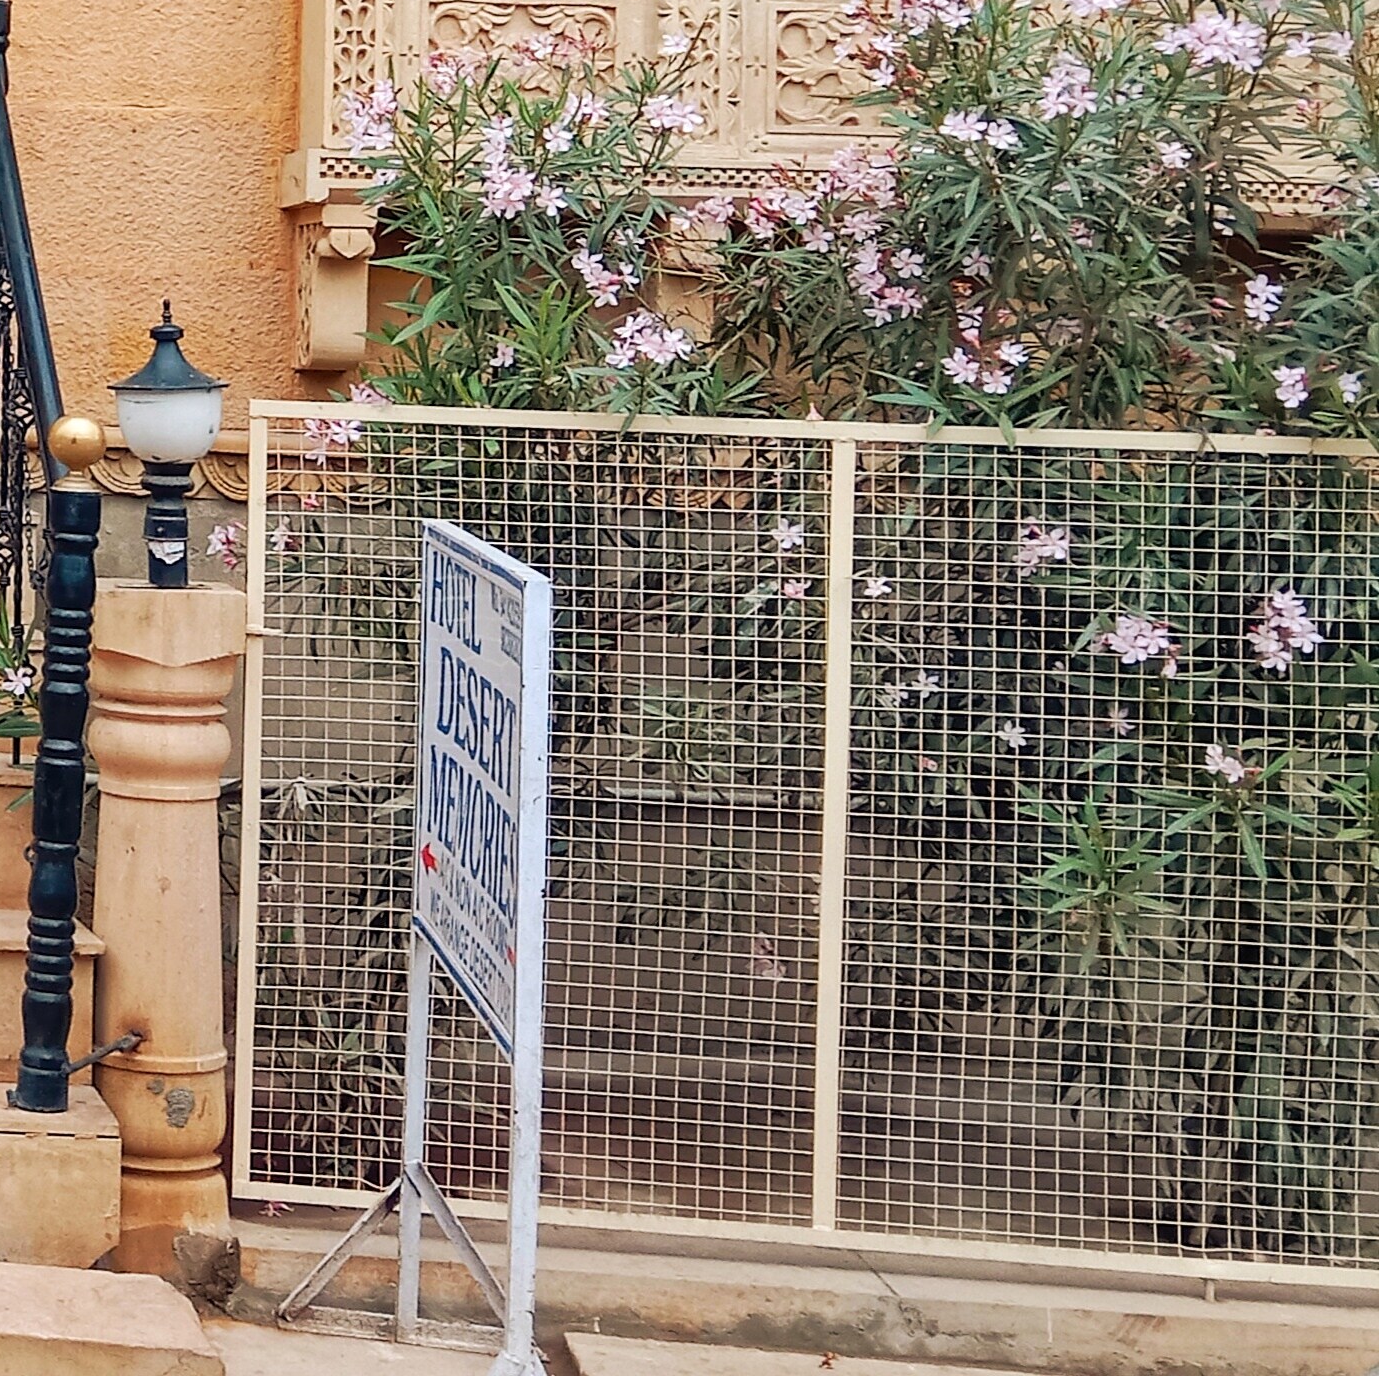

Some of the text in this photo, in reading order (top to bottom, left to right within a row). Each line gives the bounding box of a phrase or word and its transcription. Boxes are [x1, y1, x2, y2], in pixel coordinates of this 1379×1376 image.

[430, 550, 482, 656] HOTEL
[436, 646, 518, 798] DESERT
[427, 744, 517, 930] MEMORIES
